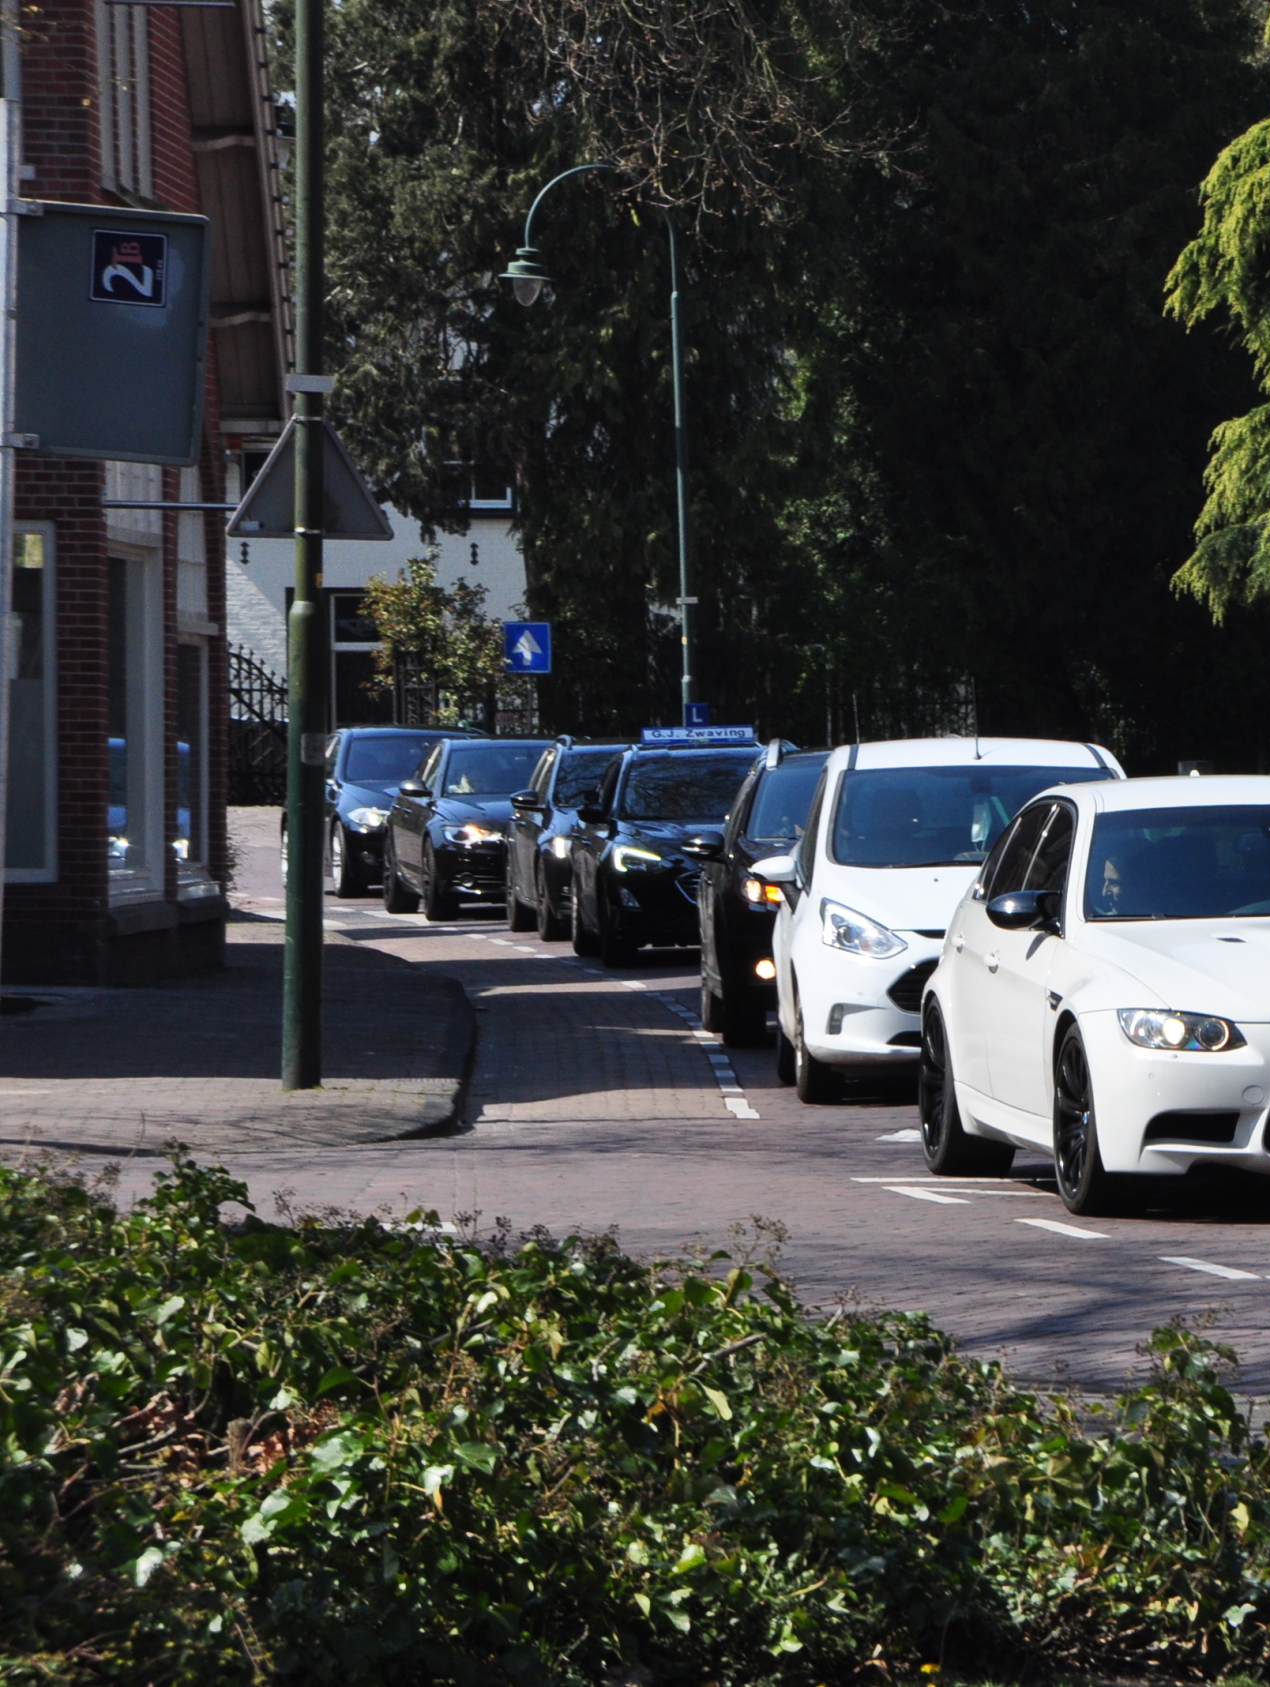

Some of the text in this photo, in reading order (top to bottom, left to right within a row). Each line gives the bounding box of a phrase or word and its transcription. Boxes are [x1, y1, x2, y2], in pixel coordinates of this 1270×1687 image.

[692, 707, 703, 723] L
[651, 728, 746, 739] G.J. Zwaving
